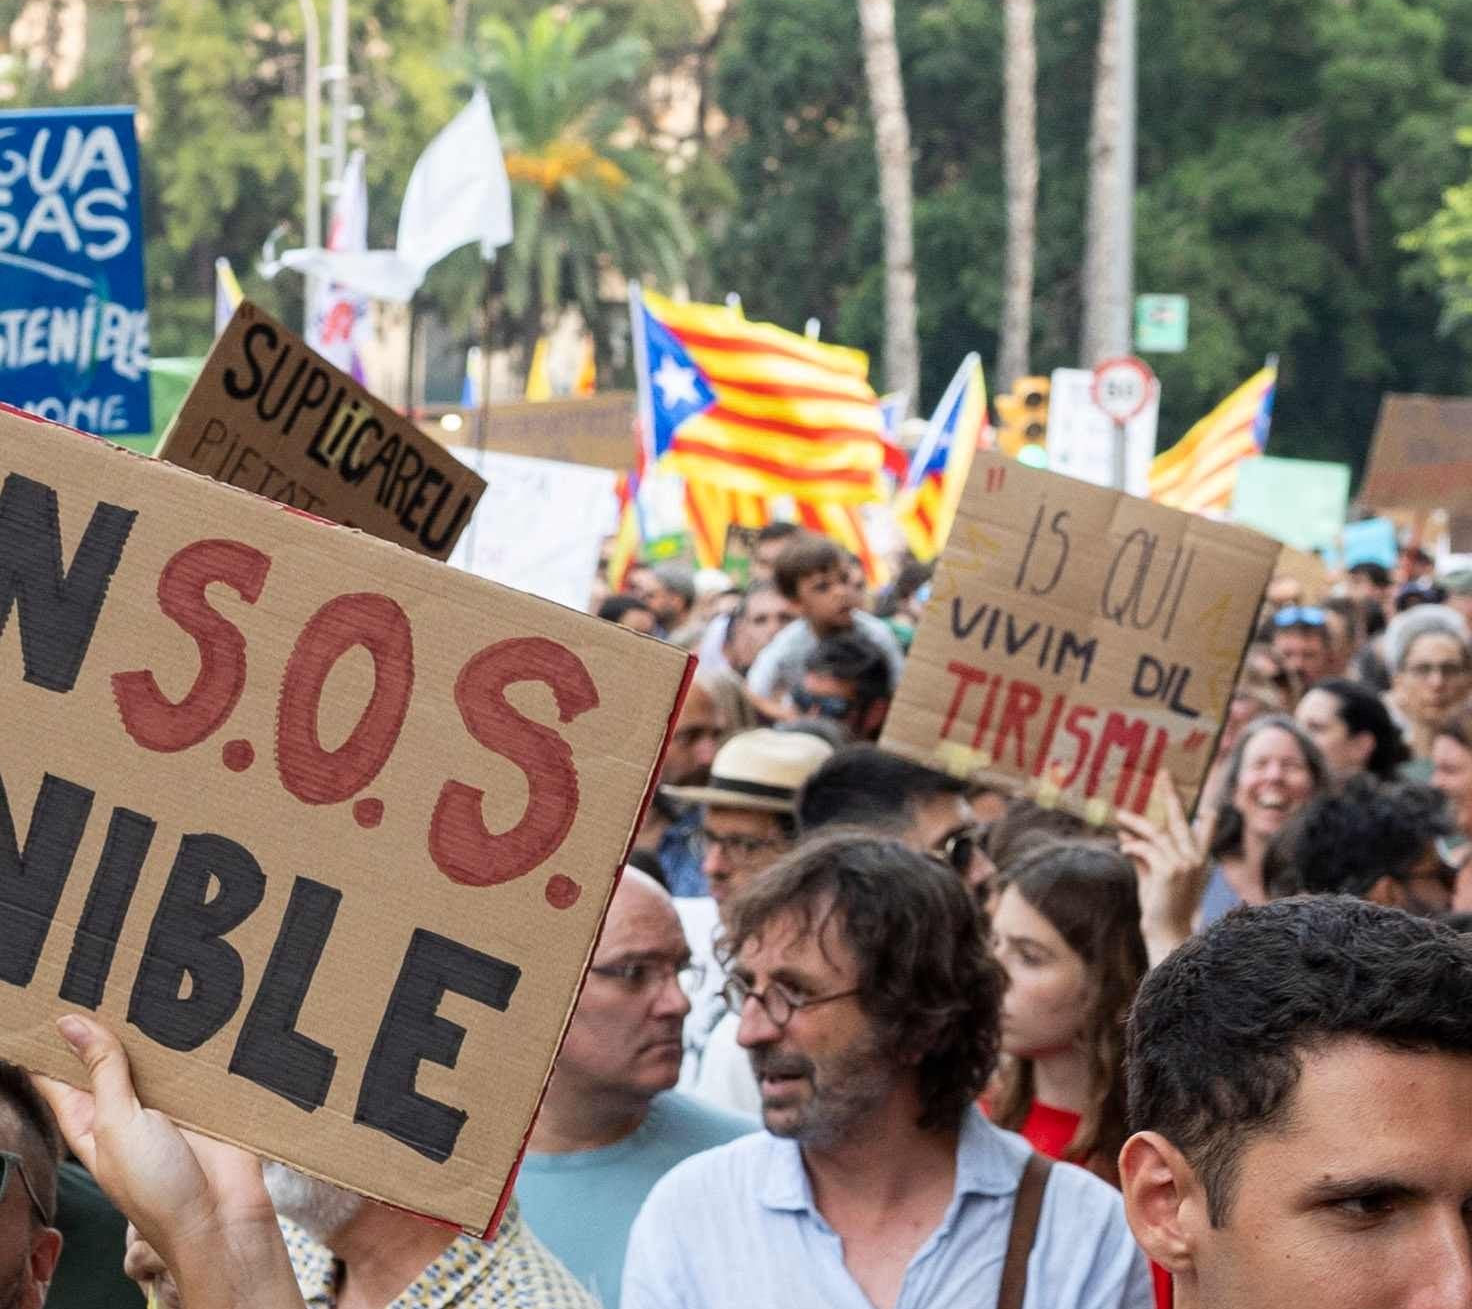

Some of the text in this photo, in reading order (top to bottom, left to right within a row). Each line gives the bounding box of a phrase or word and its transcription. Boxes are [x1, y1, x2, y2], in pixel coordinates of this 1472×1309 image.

[22, 395, 129, 432] OME
[950, 596, 1201, 718] VIVIM DIL
